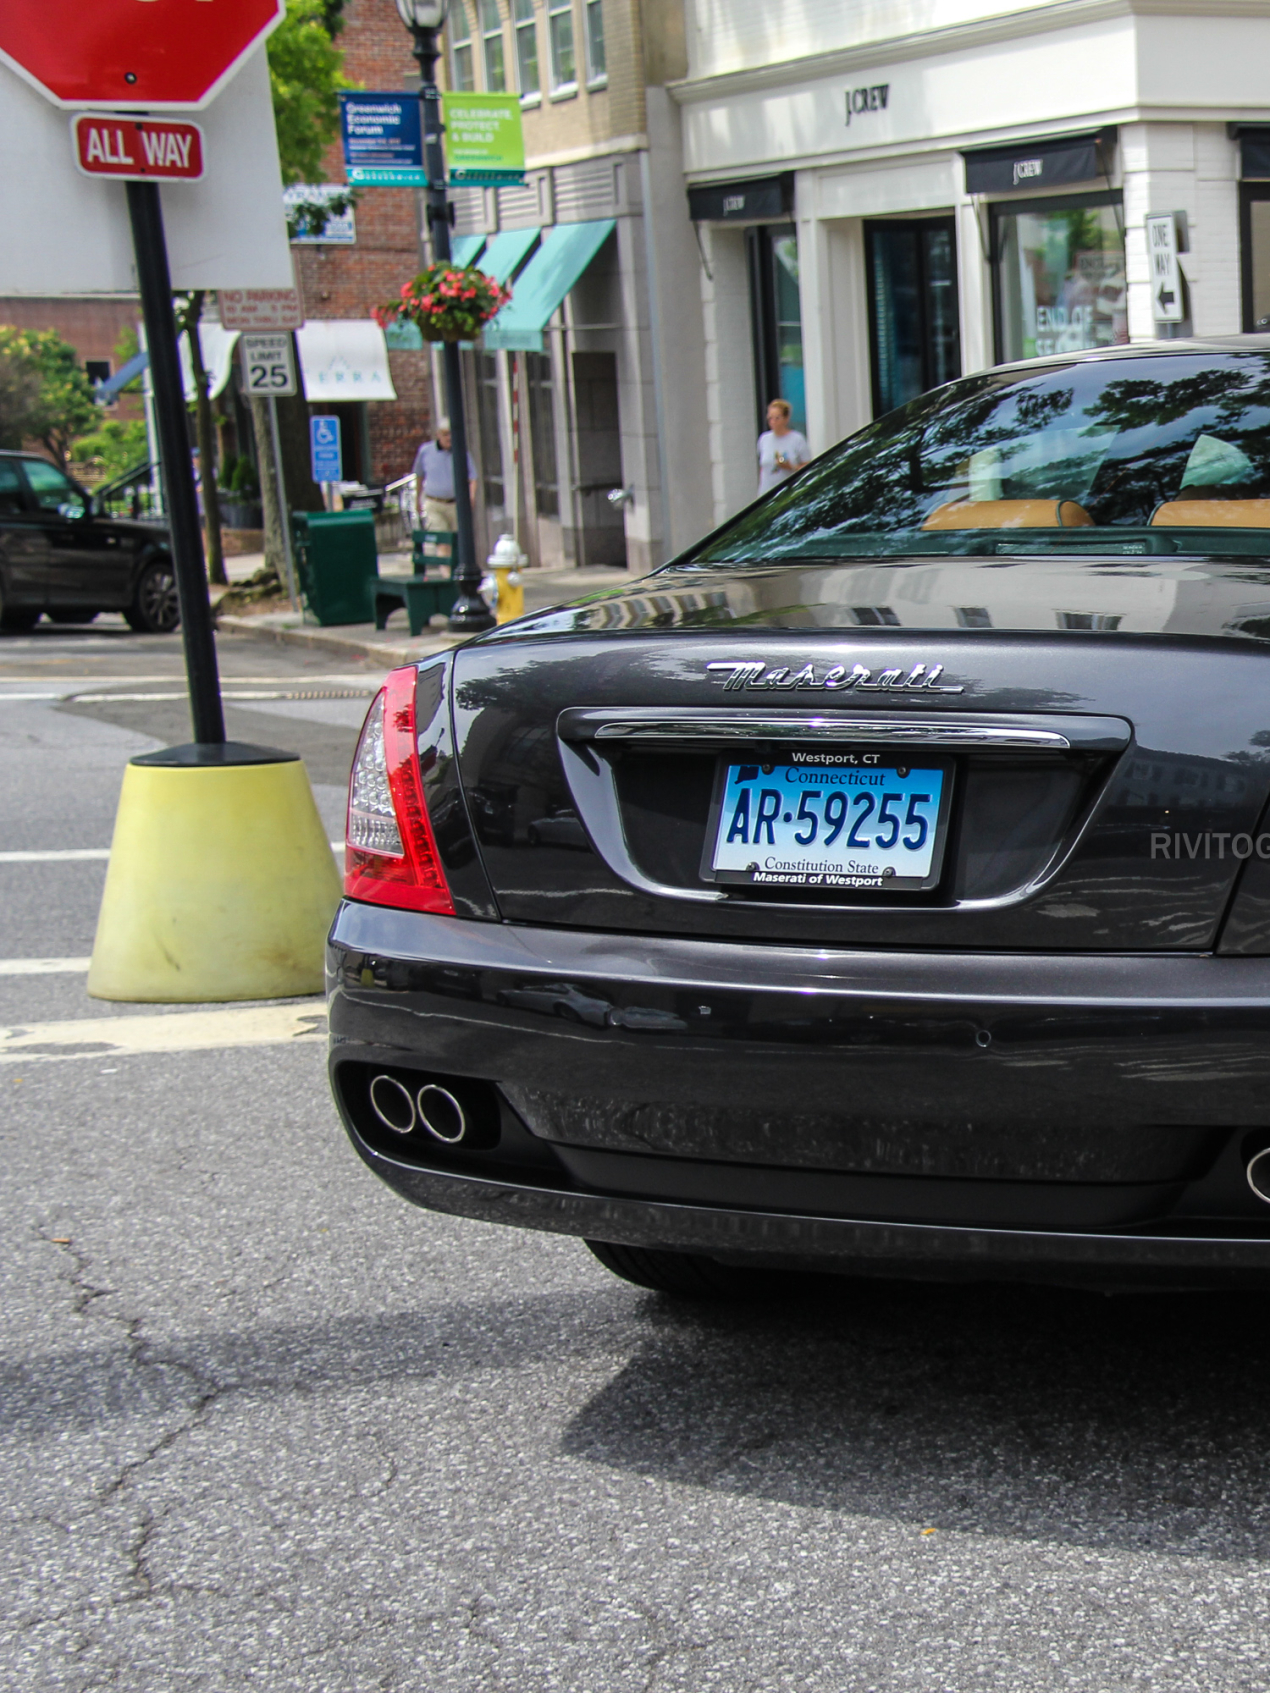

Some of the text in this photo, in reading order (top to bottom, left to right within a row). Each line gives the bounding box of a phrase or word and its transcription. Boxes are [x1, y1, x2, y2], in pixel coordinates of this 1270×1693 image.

[346, 102, 402, 114] Greenwich
[844, 83, 890, 127] J.CREW
[347, 114, 401, 125] Economic
[348, 125, 384, 136] Forum
[87, 127, 192, 168] ALL WAY
[1152, 225, 1169, 247] ONE
[1155, 253, 1171, 276] WAY
[223, 289, 298, 303] NO PARKING
[246, 336, 287, 349] SPEED
[251, 350, 281, 362] LIMIT
[250, 364, 289, 388] 25
[707, 661, 964, 693] Maserati
[792, 752, 880, 765] Westport, CT
[785, 766, 886, 786] Connecticut
[764, 856, 879, 874] Constitution State
[753, 872, 883, 888] Maserati of Westport
